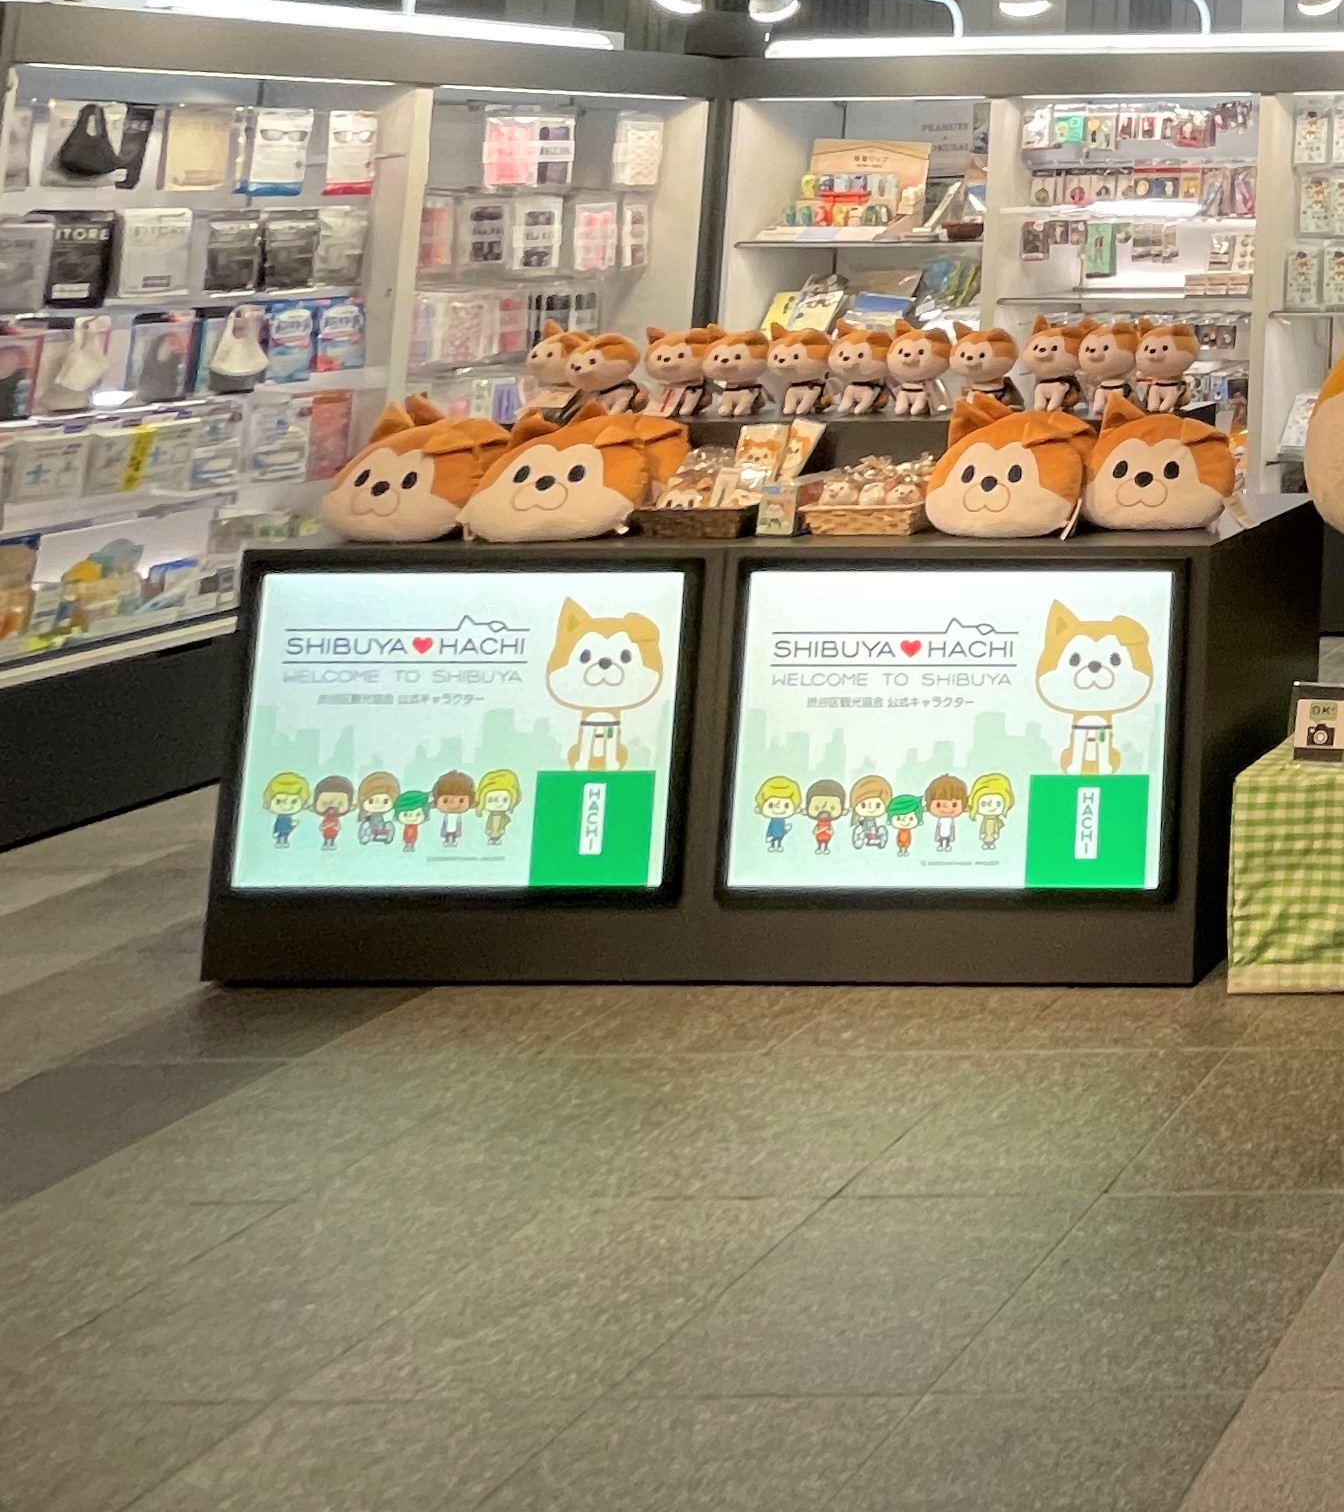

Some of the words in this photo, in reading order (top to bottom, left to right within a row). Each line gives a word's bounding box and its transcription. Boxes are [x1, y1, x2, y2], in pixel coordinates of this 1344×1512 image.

[286, 637, 408, 655] SHIBUYA
[439, 637, 526, 655] HACHI
[773, 640, 896, 658] SHIBUYA
[927, 640, 1014, 658] HACHI
[283, 669, 380, 684] WELCOME
[394, 669, 421, 684] TO
[432, 669, 523, 684] SHIBUYA
[772, 673, 869, 687] WELCOME
[882, 673, 909, 687] TO
[921, 673, 1012, 687] SHIBUYA
[585, 788, 601, 850] HACHI
[1081, 792, 1095, 854] HACHI
